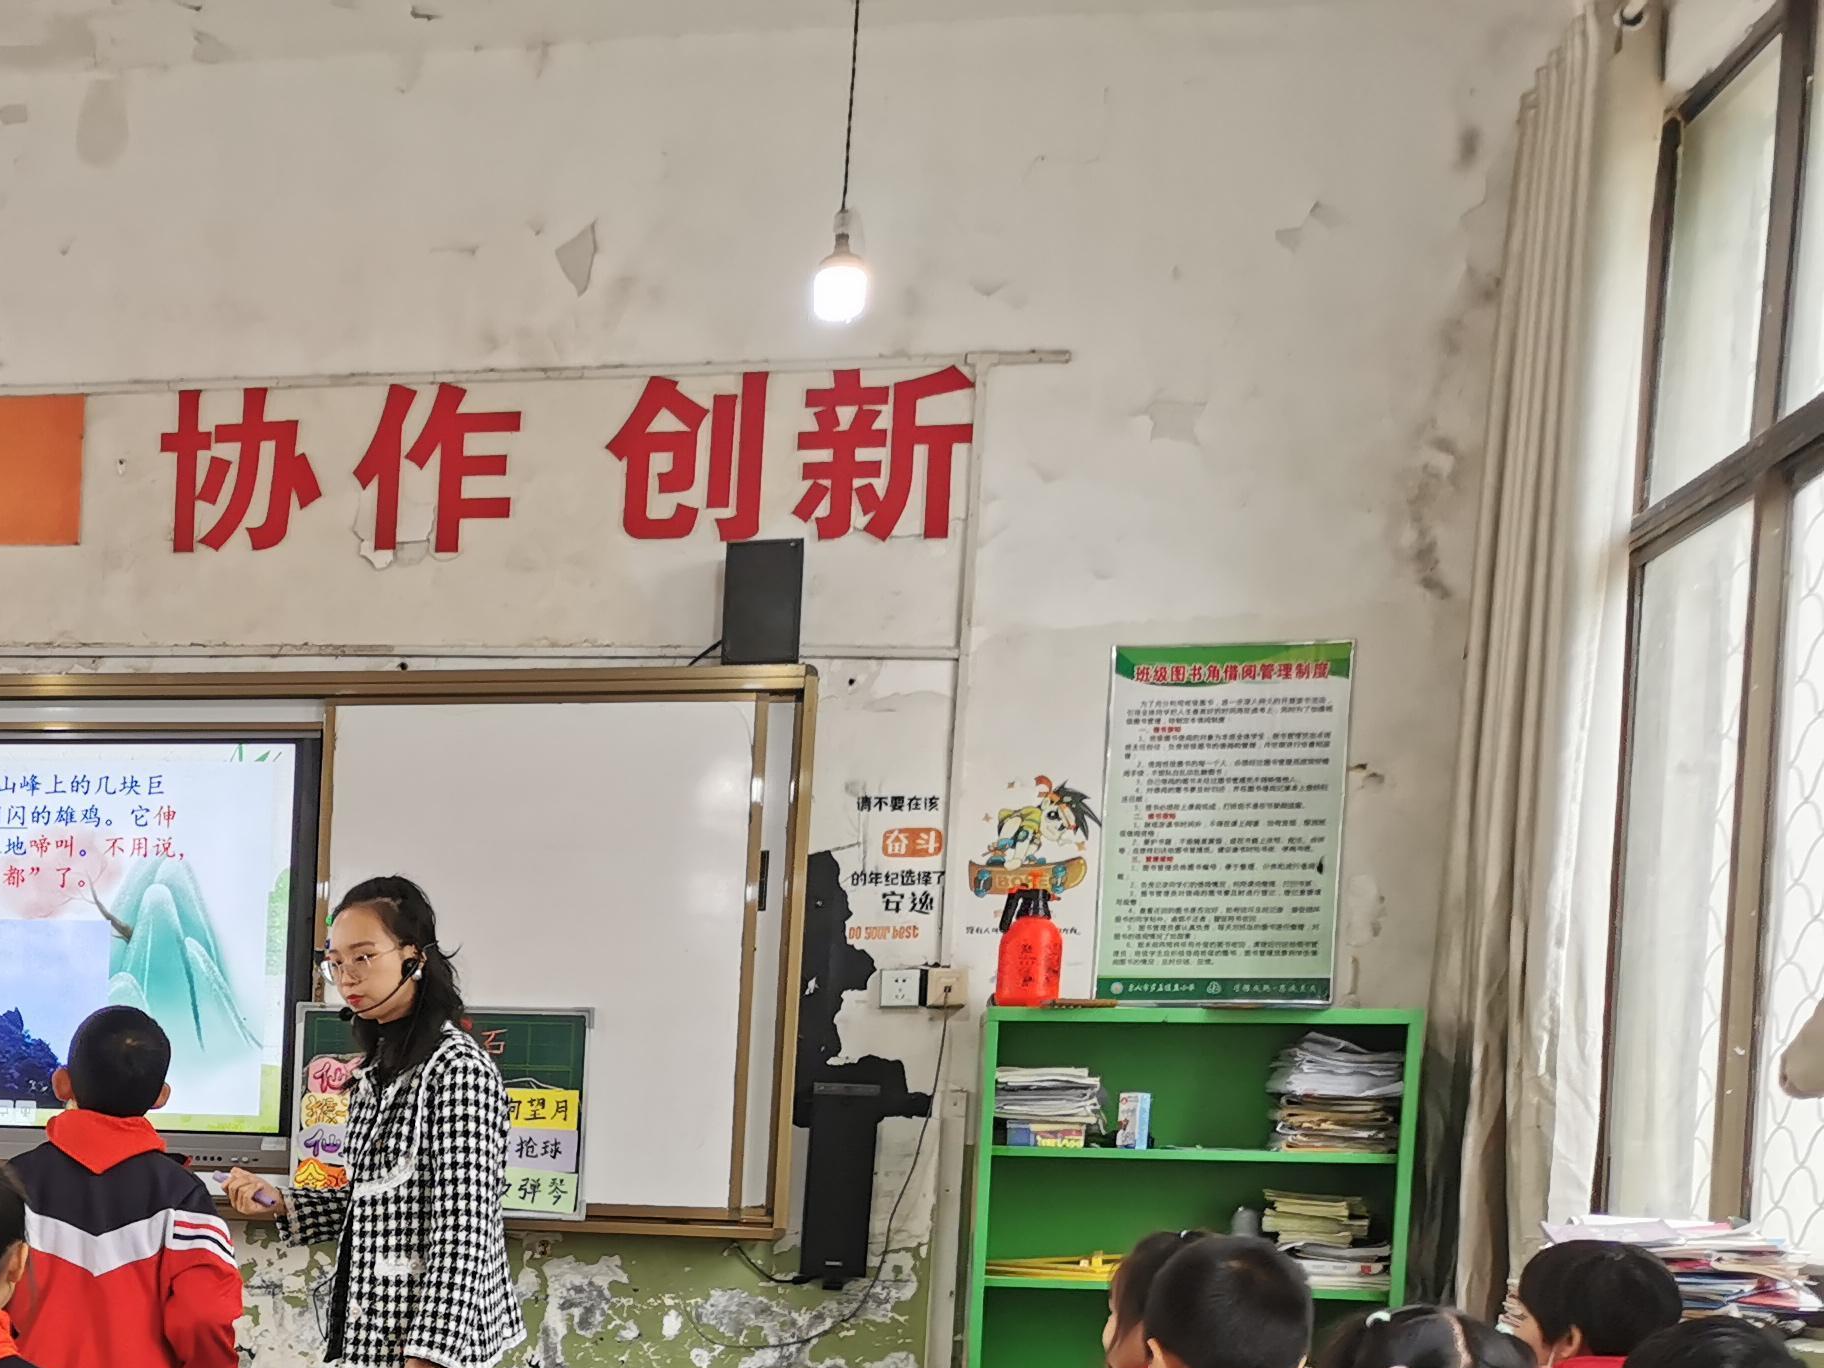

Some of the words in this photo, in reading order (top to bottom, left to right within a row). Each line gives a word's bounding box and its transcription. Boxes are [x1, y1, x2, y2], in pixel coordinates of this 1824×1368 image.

[160, 381, 522, 554] 协作
[605, 365, 976, 544] 创新
[1134, 662, 1330, 683] 班级图书角借阅管理制度
[856, 795, 940, 812] 请不要在该
[886, 830, 940, 855] 奋斗
[851, 869, 945, 887] 的年纪选择了
[882, 891, 935, 915] 安逸
[891, 925, 919, 940] best
